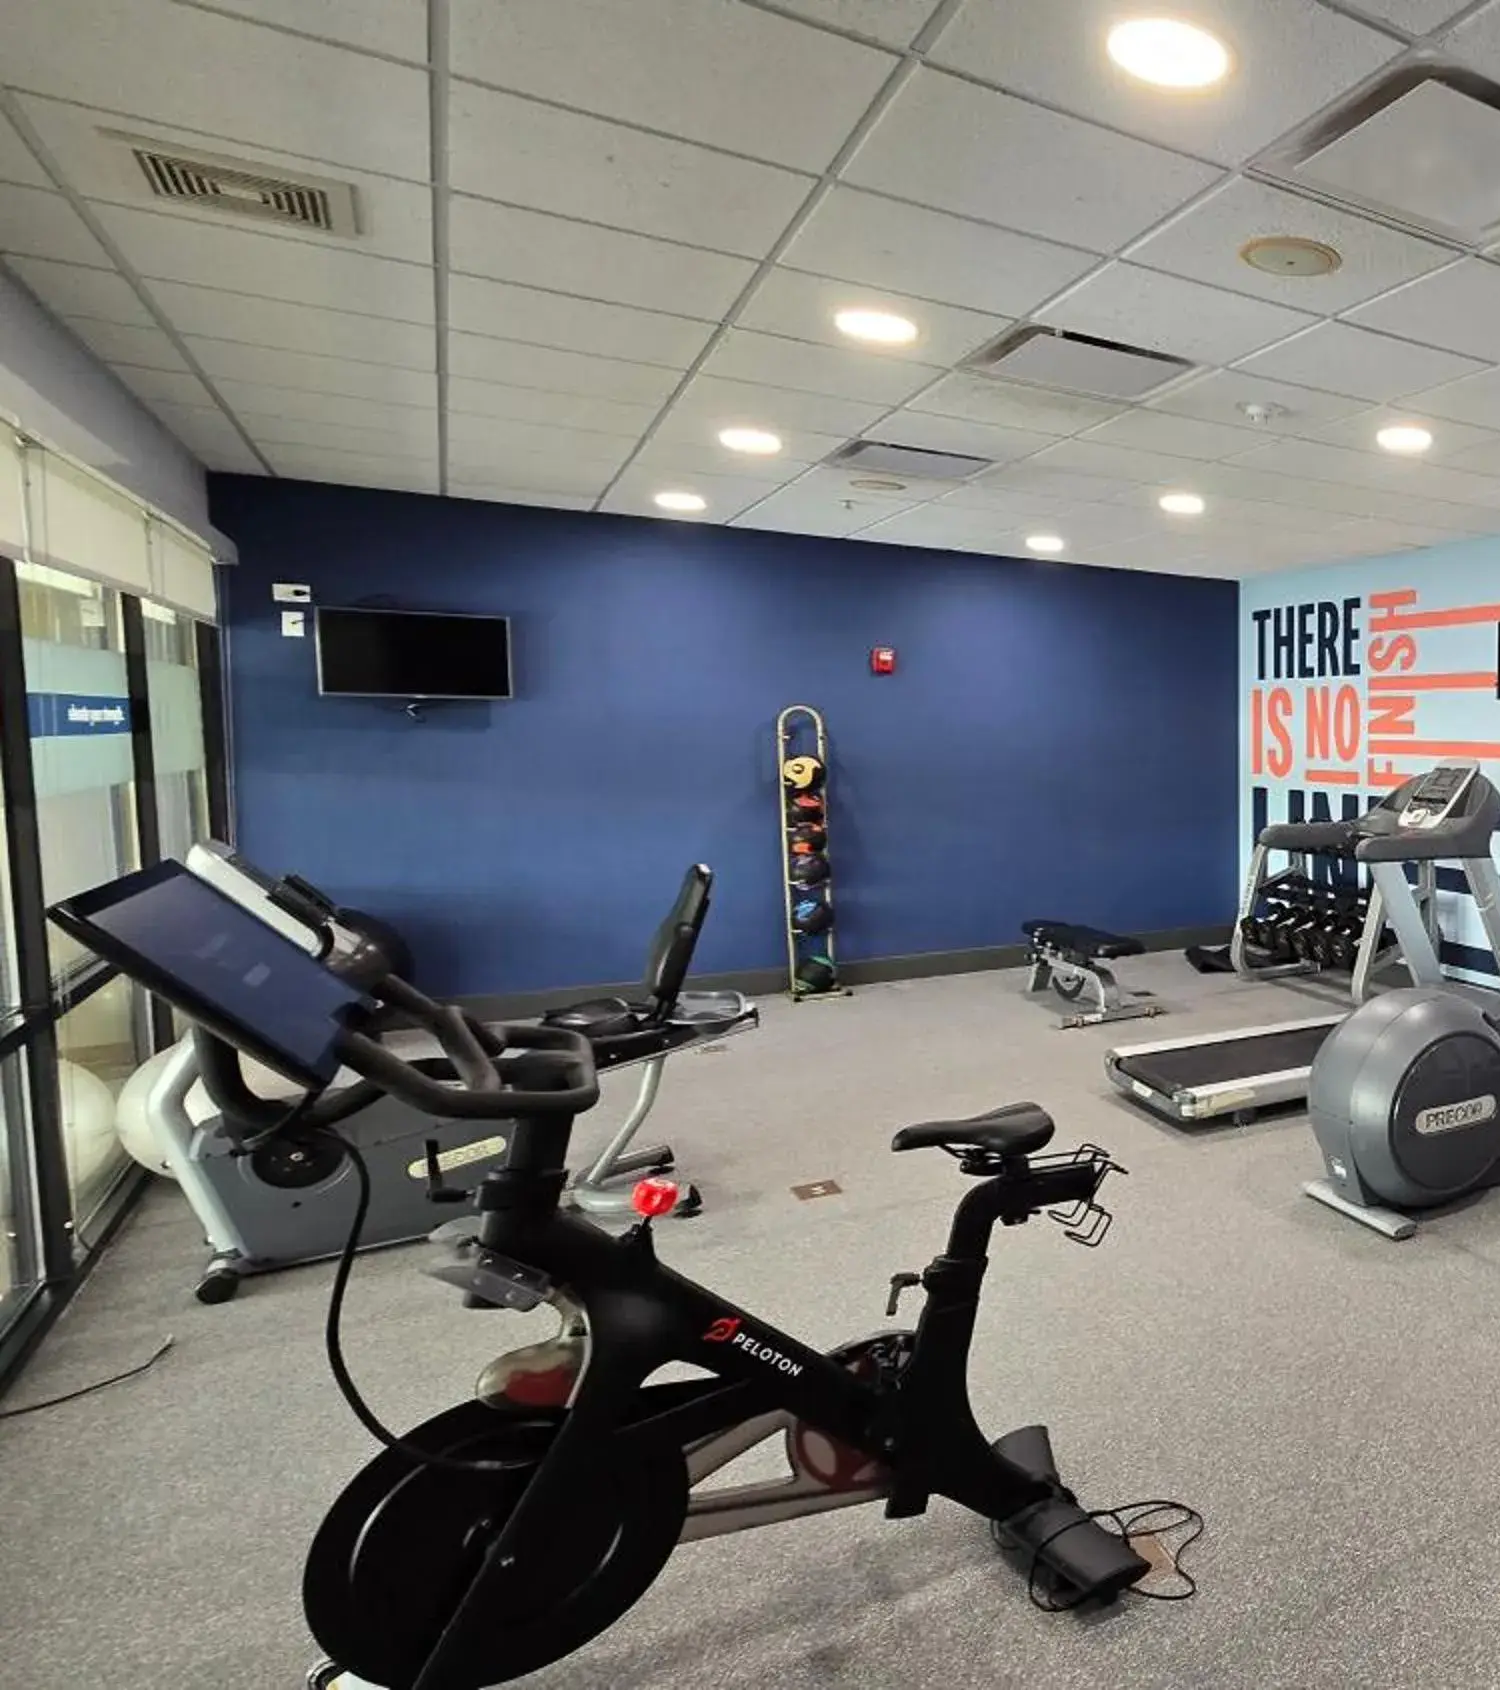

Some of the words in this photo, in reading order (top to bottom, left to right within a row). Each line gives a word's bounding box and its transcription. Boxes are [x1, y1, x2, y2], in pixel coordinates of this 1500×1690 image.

[1252, 597, 1361, 680] THERE
[1368, 589, 1417, 787] FINISH
[1252, 687, 1292, 777] IS
[1306, 684, 1360, 762] NO
[1425, 1102, 1482, 1129] PRECOR
[732, 1332, 803, 1377] PELOTON
